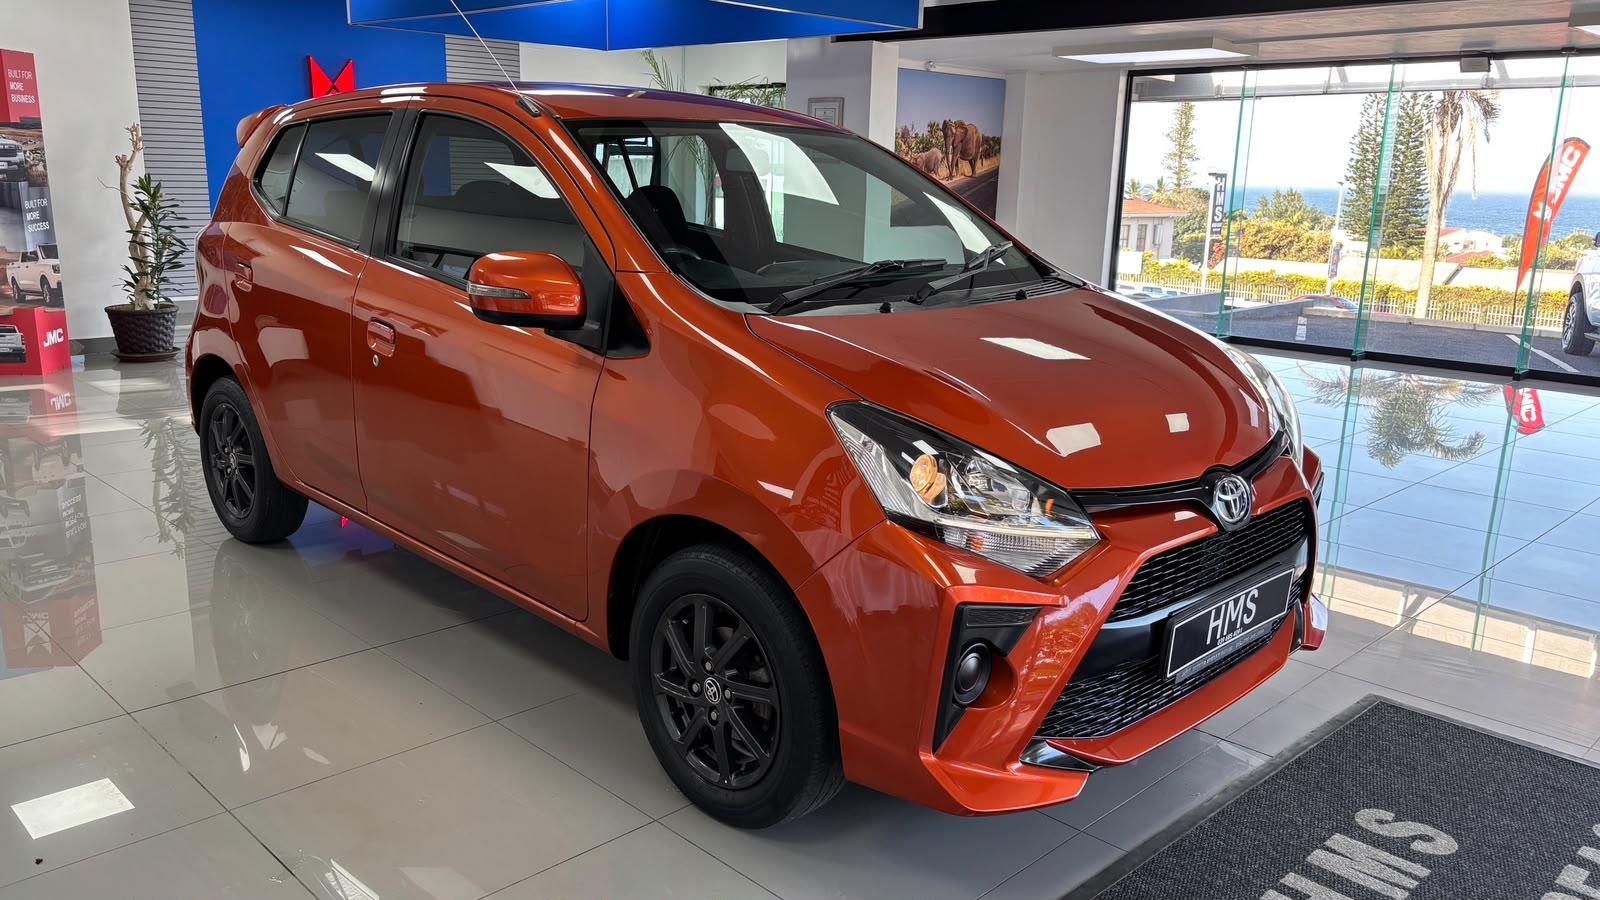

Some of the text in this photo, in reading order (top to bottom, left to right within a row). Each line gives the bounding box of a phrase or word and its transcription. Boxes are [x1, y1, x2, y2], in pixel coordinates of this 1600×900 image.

[8, 69, 32, 79] BUILT FOR
[9, 82, 24, 91] MORE
[11, 94, 35, 104] BUSINESS
[25, 198, 48, 209] BUILT FOR
[1213, 177, 1225, 222] HMS
[26, 211, 40, 220] MORE
[28, 222, 50, 232] SUCCESS
[43, 328, 64, 347] JMC
[1206, 588, 1259, 645] HMS
